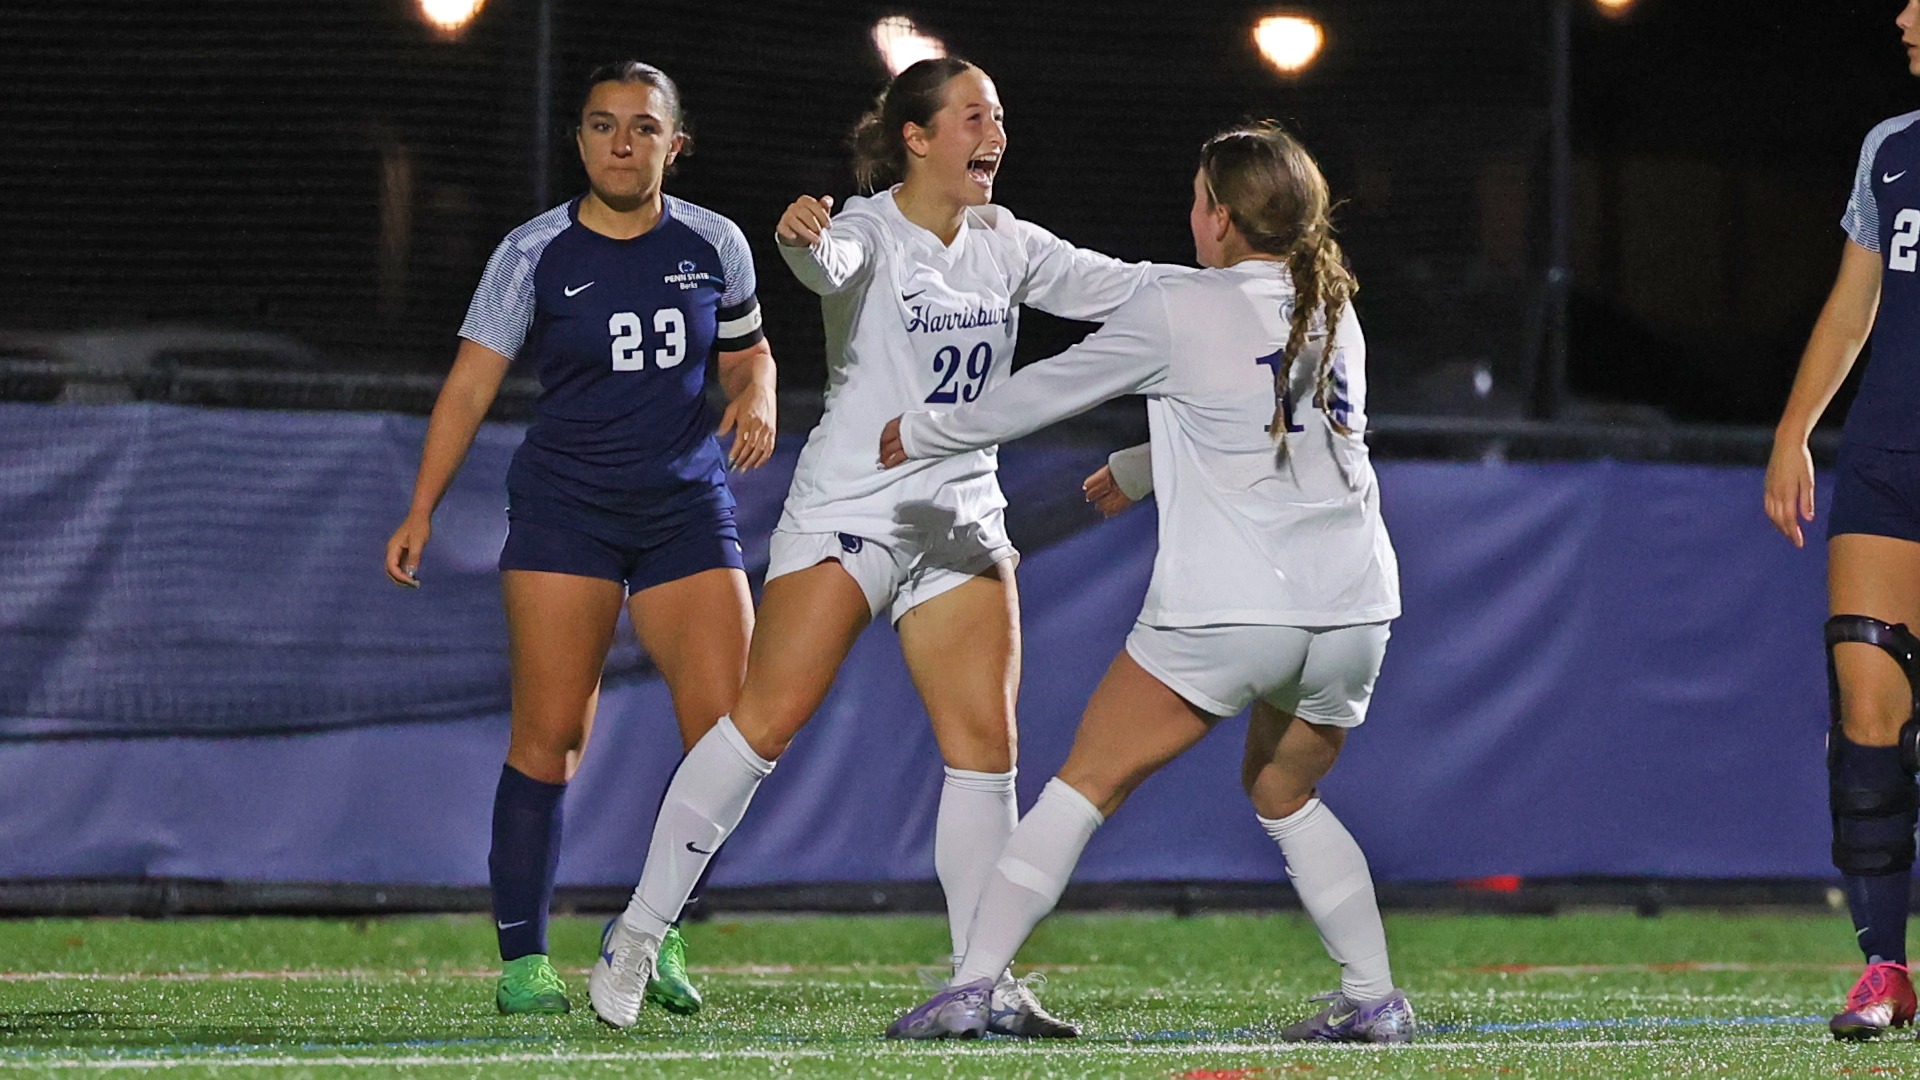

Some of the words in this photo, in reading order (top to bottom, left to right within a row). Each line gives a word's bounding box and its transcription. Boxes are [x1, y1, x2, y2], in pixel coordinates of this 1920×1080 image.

[1889, 208, 1920, 273] 2
[664, 274, 687, 283] PENN
[688, 273, 709, 281] STATE
[680, 282, 698, 290] Berks
[608, 307, 687, 372] 23
[907, 304, 1010, 333] Harrisbur
[924, 341, 993, 404] 29
